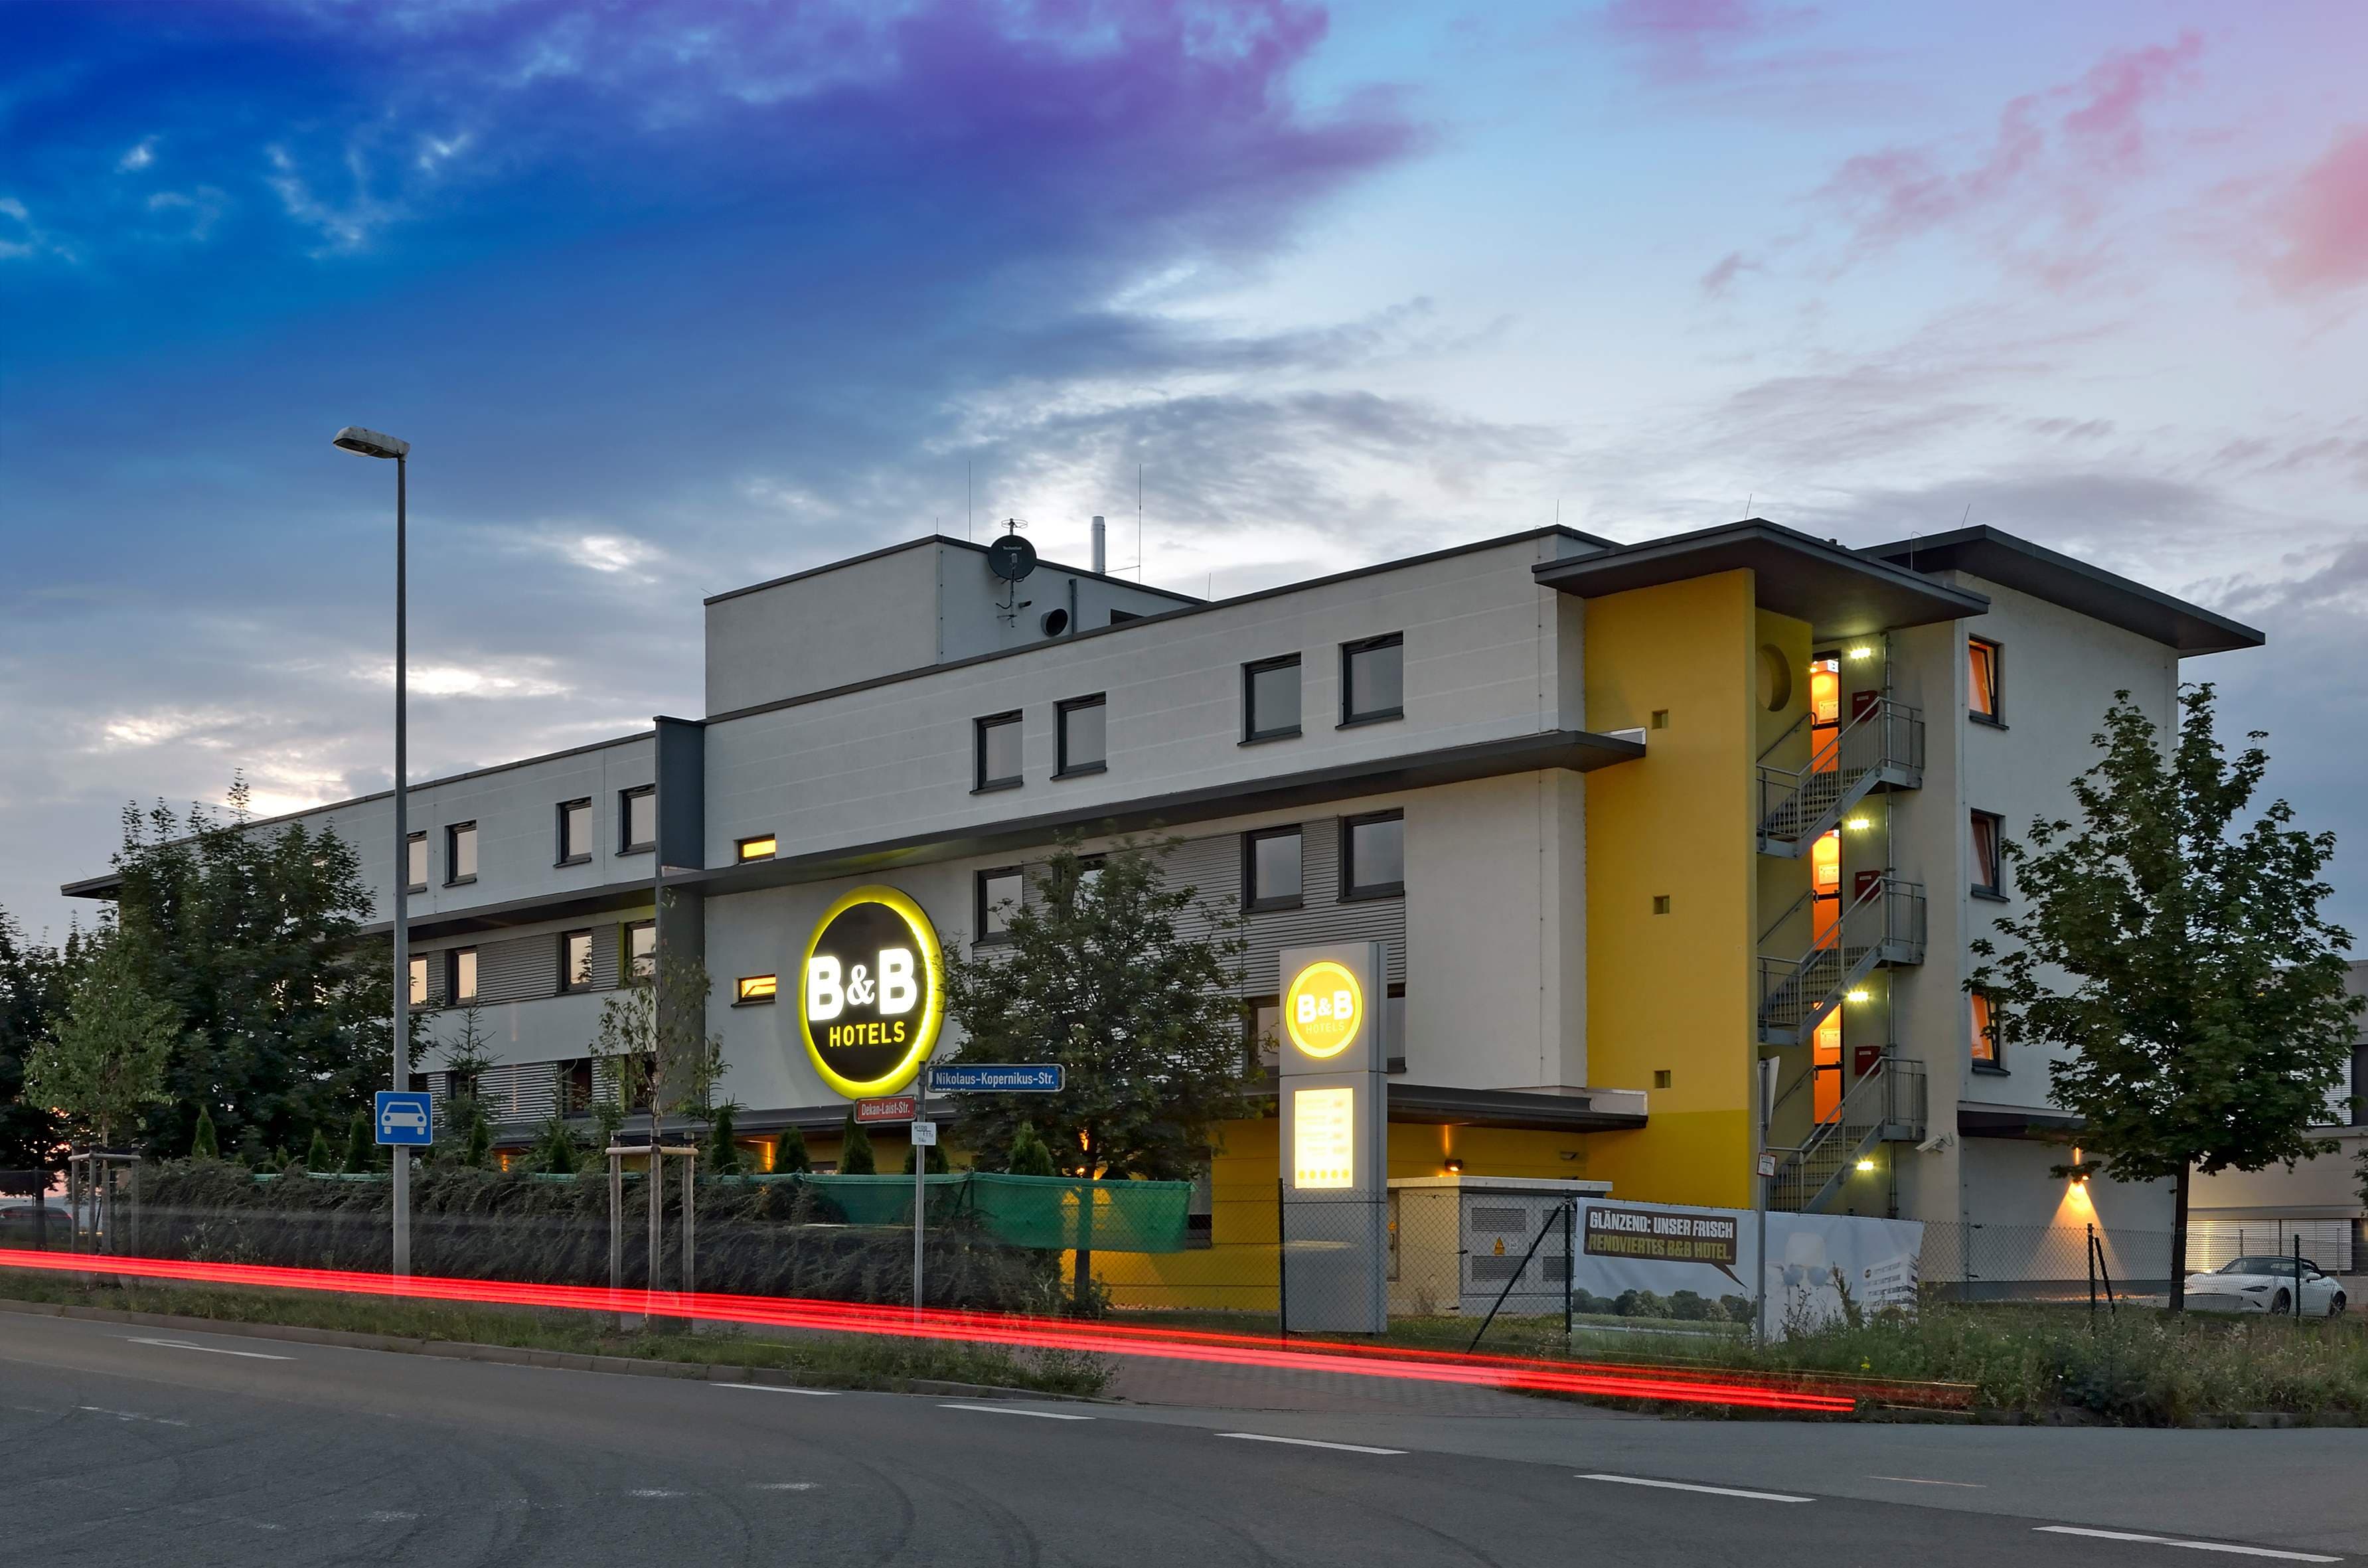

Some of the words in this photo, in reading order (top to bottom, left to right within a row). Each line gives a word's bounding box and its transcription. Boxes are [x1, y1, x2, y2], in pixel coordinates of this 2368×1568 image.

[808, 947, 918, 1021] B&B
[1297, 990, 1354, 1024] B&B
[829, 1021, 906, 1048] HOTELS
[1306, 1022, 1345, 1034] HOTELS
[935, 1071, 1054, 1088] Nikolaus-Kopernikus-Str.
[861, 1101, 910, 1116] Dekan-Laist-Str.
[1589, 1210, 1651, 1233] GLÄNZEND:
[1653, 1217, 1691, 1236] UNSER
[1692, 1220, 1733, 1239] FRISCH
[1588, 1233, 1665, 1256] RENOVIERTES
[1667, 1239, 1692, 1257] B&B
[1694, 1241, 1732, 1260] HOTEL.
